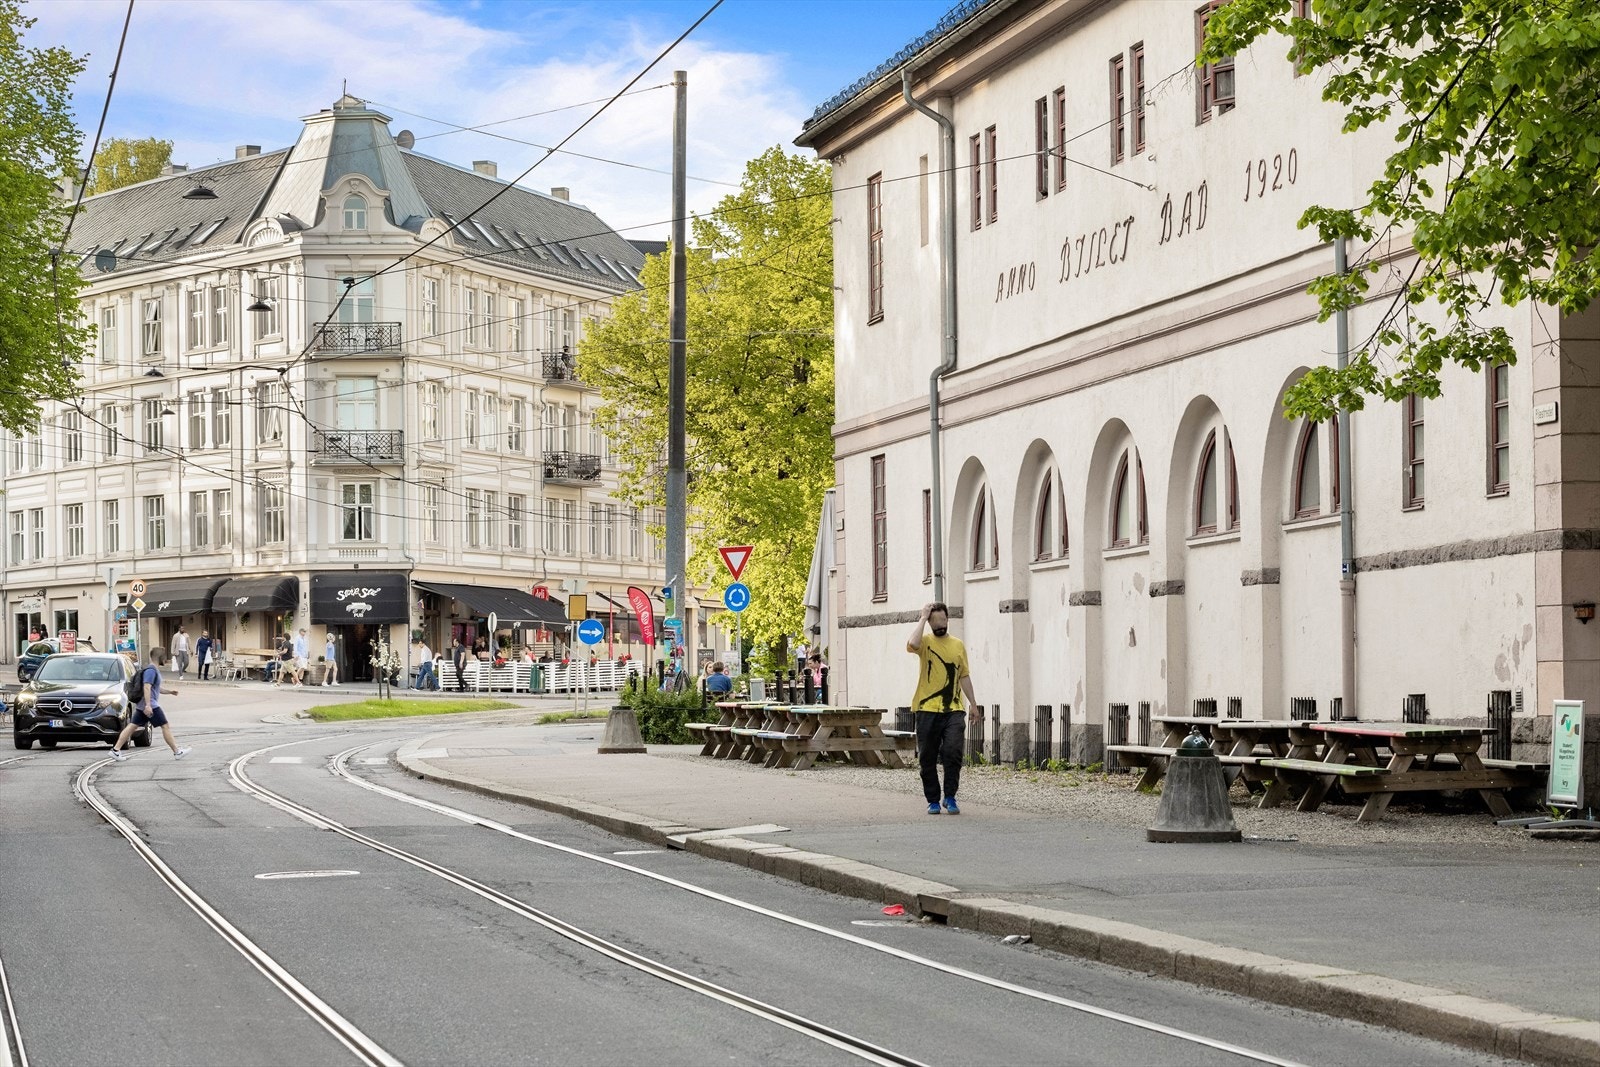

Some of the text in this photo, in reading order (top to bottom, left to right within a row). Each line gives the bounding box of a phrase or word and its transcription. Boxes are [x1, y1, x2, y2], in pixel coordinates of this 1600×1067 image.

[995, 148, 1297, 303] ANNO BISLET BAD 1920
[133, 584, 144, 593] 40
